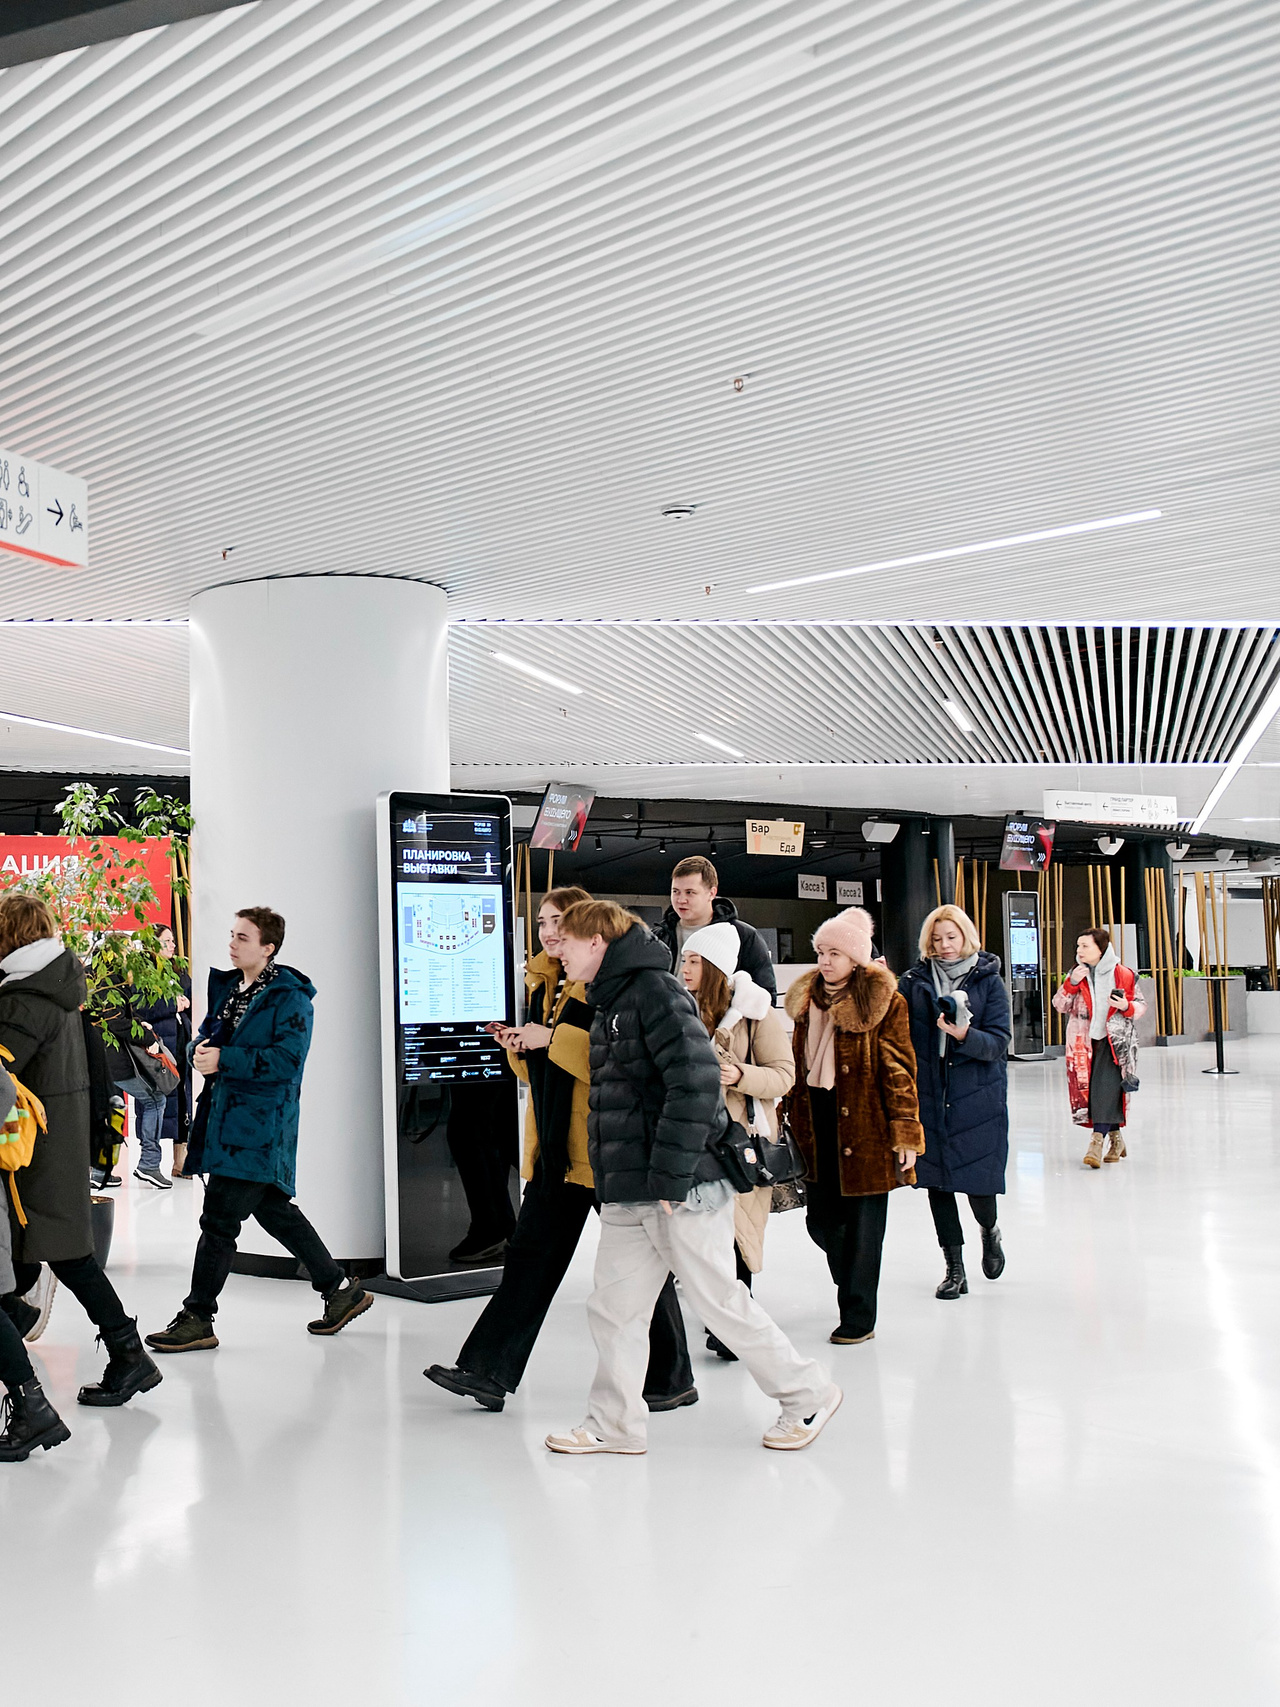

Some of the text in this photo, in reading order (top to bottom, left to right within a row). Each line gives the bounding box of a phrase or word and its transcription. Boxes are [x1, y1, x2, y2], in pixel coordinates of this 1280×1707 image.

[751, 822, 770, 836] Бар
[780, 842, 796, 854] Еда
[403, 849, 472, 862] ПЛАНИРОВКА
[403, 862, 458, 875] ВЫСТАВКИ
[801, 880, 825, 892] Касса 3
[839, 887, 862, 898] Касса 2
